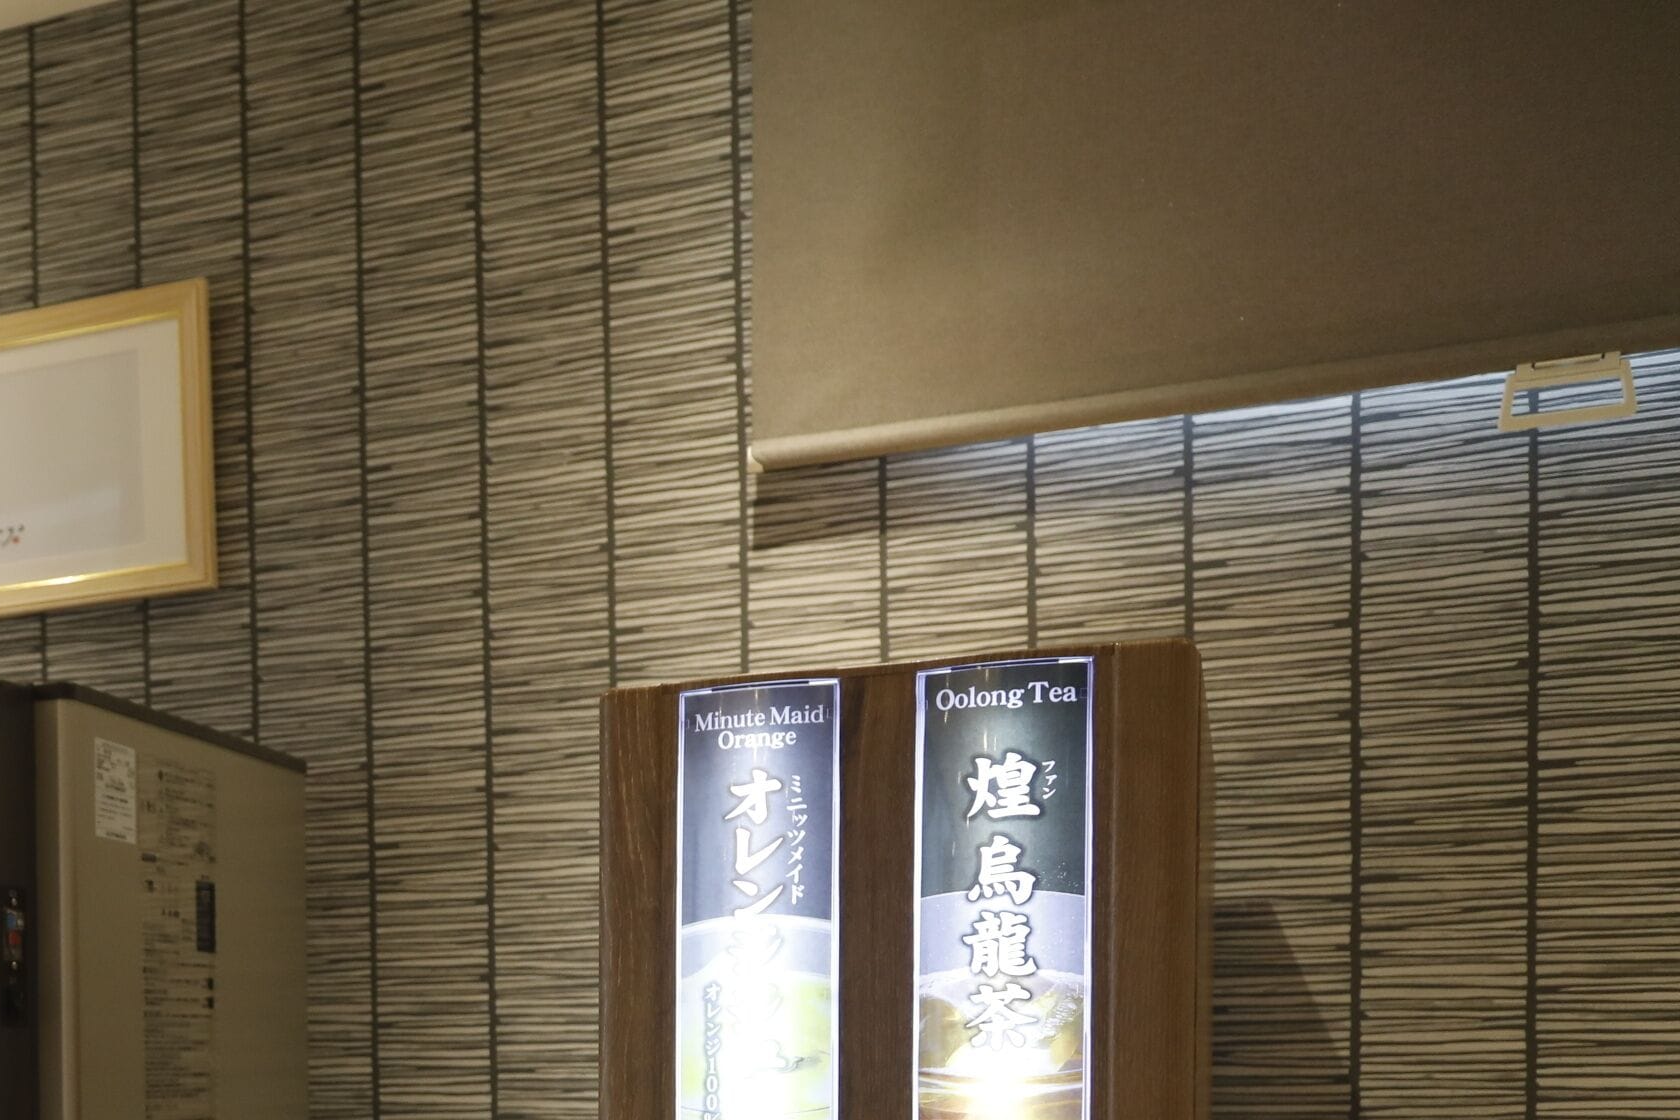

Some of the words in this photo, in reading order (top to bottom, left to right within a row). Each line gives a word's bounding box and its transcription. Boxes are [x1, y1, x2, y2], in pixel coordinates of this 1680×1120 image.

[935, 685, 1024, 712] Oolong
[1025, 680, 1078, 704] Tea
[694, 709, 766, 732] Minute
[769, 704, 825, 725] Maid
[718, 729, 797, 750] Orange
[786, 774, 809, 905] ミニッツメイド
